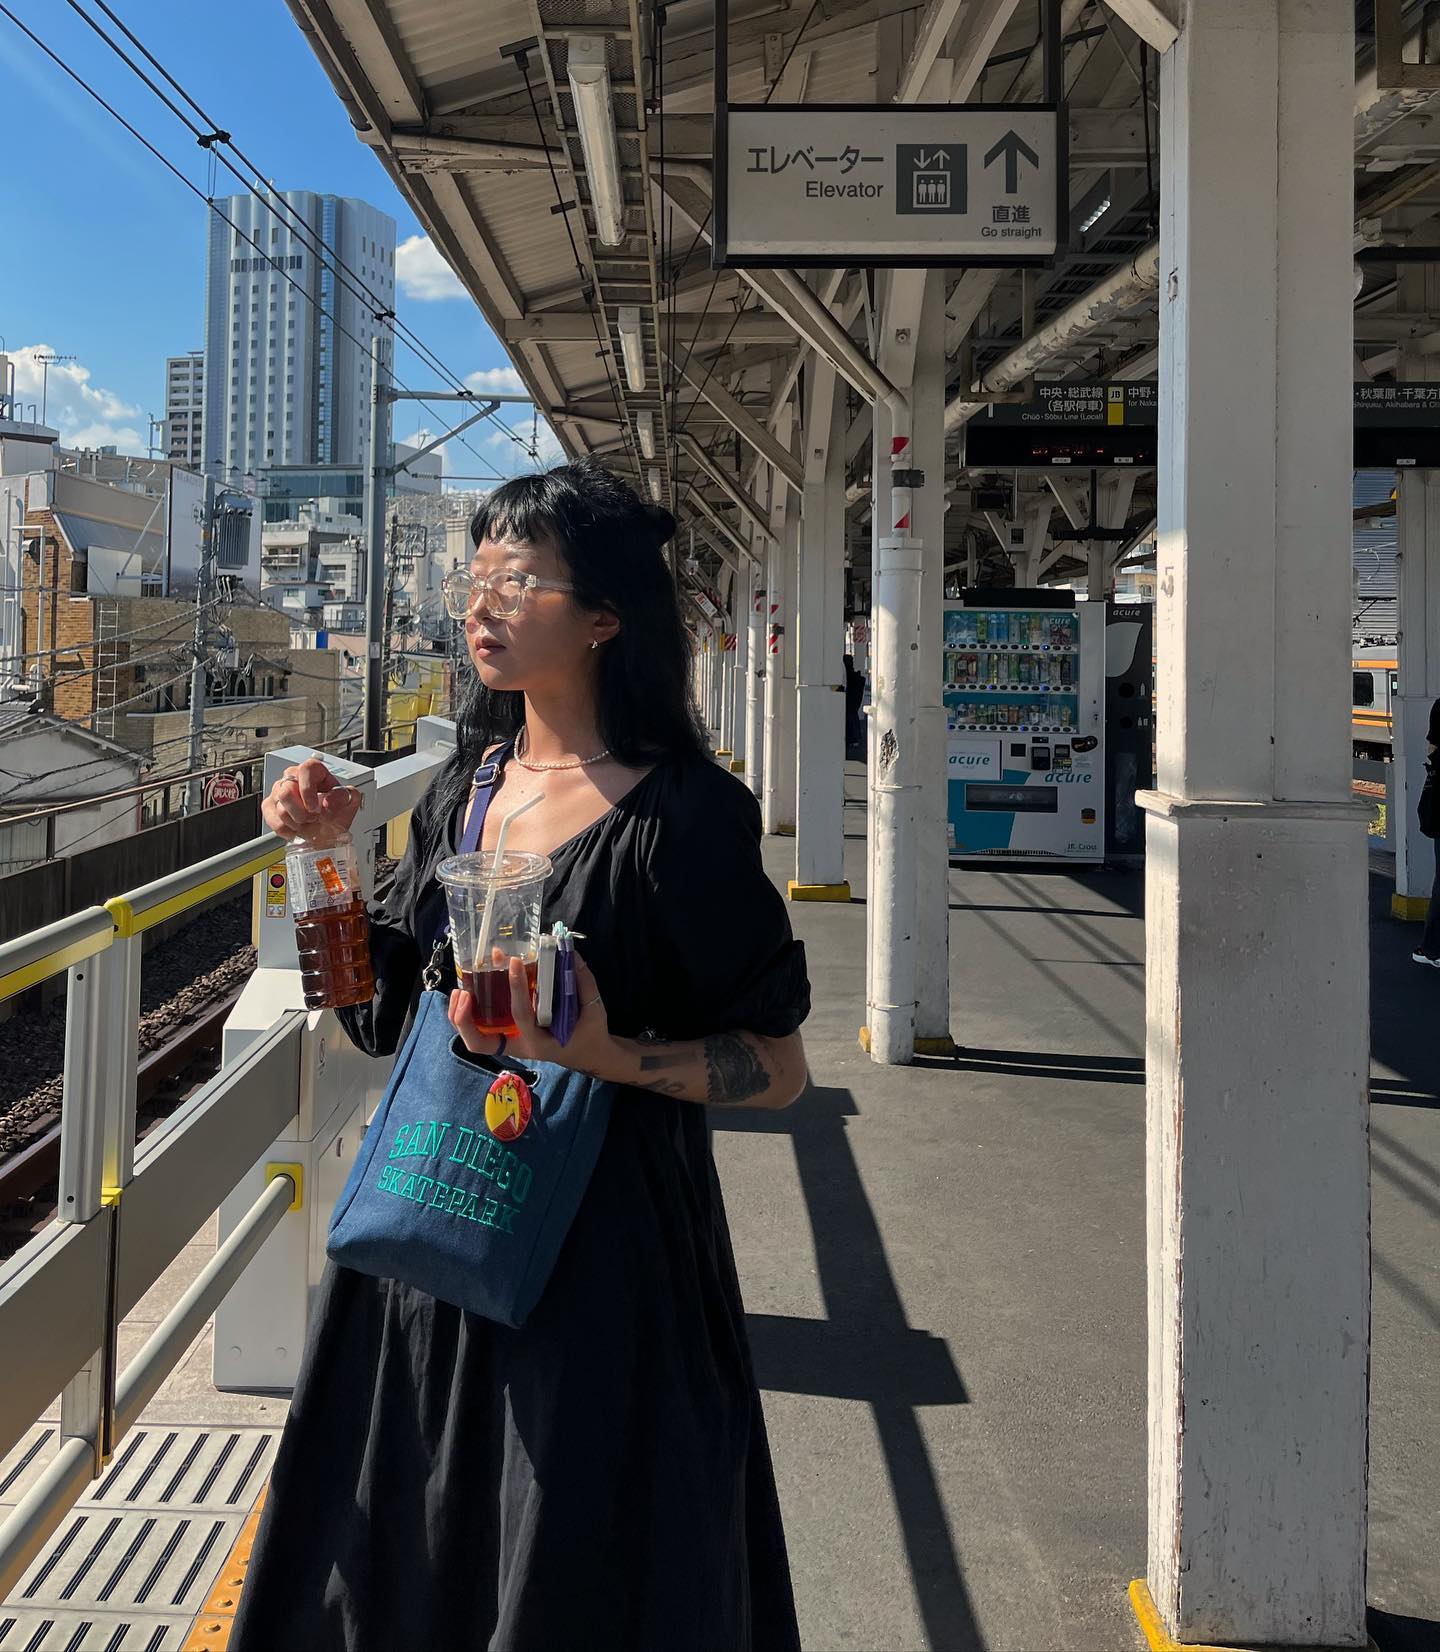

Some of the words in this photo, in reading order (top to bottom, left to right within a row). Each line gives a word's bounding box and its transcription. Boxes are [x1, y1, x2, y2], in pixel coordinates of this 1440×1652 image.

[746, 145, 884, 175] エレベーター
[805, 180, 884, 198] Elevator
[992, 204, 1031, 224] 直進
[981, 226, 997, 238] Go
[1001, 226, 1043, 239] straight
[1110, 390, 1121, 399] JB
[1063, 413, 1079, 421] Line
[1112, 608, 1141, 617] acure
[1049, 616, 1071, 625] cure
[948, 755, 990, 765] acure
[1044, 772, 1092, 784] acure
[388, 1120, 452, 1161] SAN
[448, 1126, 533, 1204] DIEGO
[376, 1165, 521, 1235] SKATEPARK
